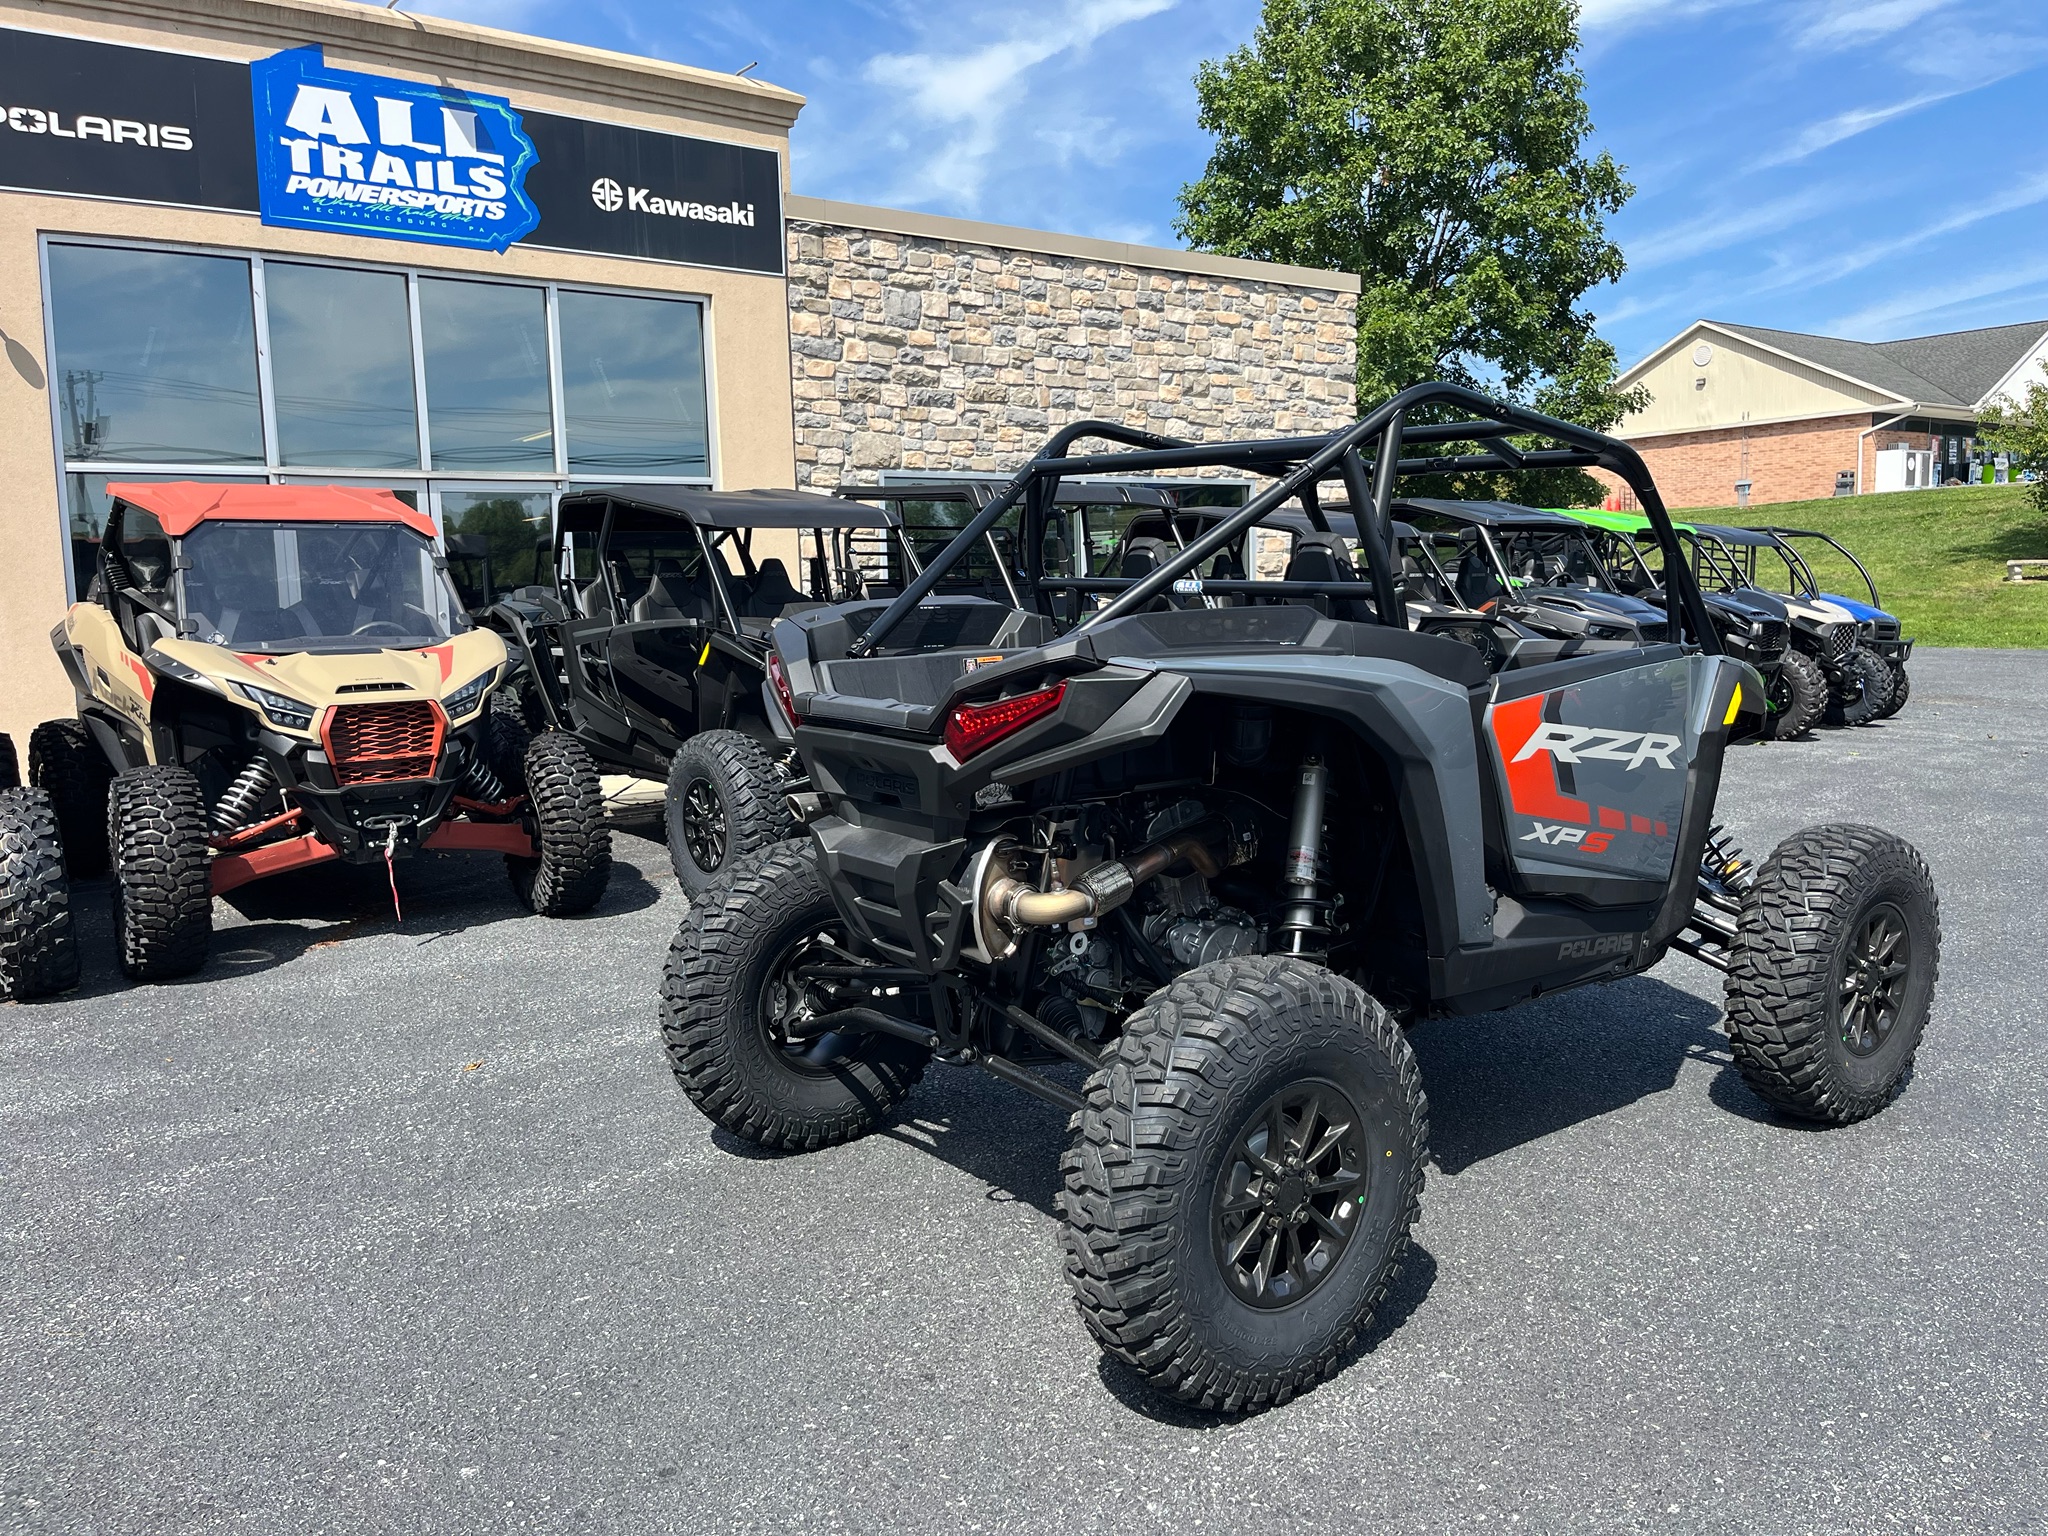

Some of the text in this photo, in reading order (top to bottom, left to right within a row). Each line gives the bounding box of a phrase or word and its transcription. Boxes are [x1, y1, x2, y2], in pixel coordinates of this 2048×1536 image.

[0, 105, 194, 151] OLARIS
[285, 84, 505, 168] ALL
[280, 136, 507, 200] TRAILS
[285, 175, 508, 221] POWERSPORTS
[398, 205, 437, 219] Trails
[627, 186, 755, 227] Kawasaki
[468, 225, 485, 233] PA
[1500, 603, 1539, 614] XP
[1510, 721, 1683, 772] RZR
[856, 772, 916, 796] POLARIS
[1518, 821, 1616, 854] XPS
[1557, 932, 1634, 961] POLARIS
